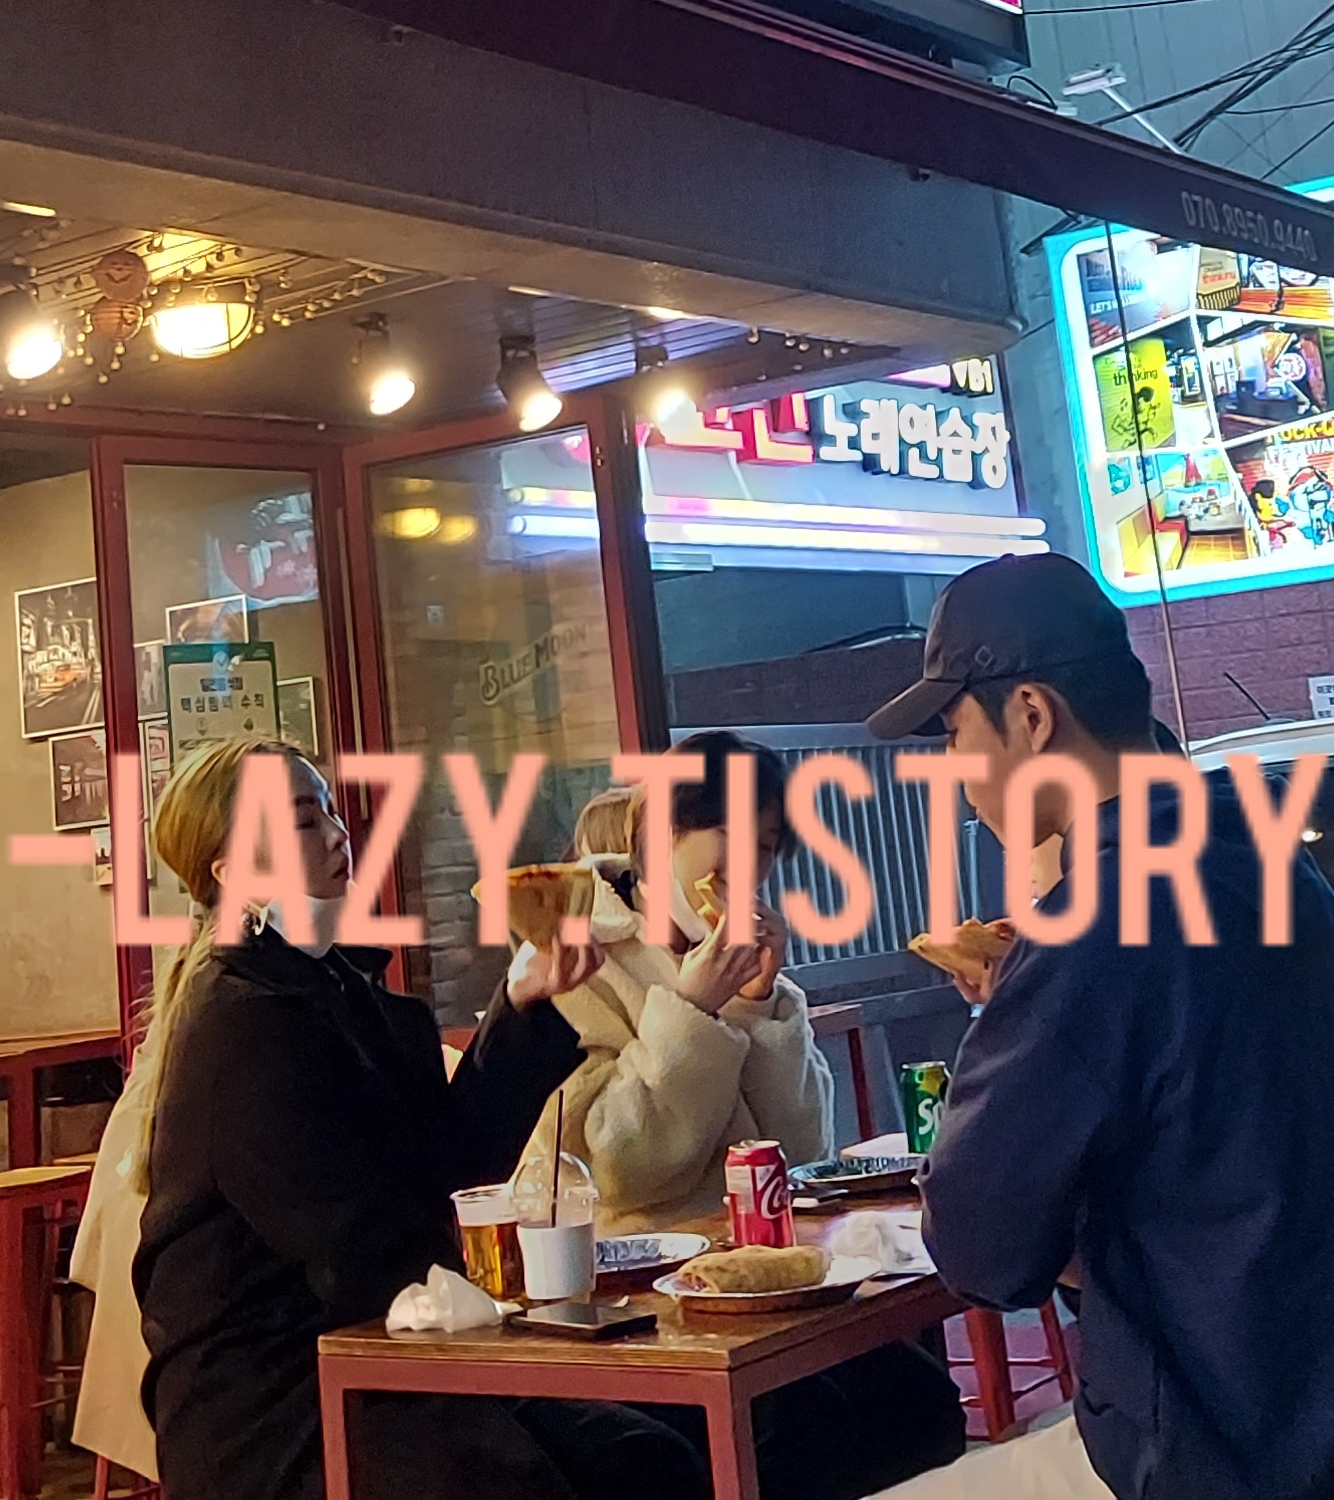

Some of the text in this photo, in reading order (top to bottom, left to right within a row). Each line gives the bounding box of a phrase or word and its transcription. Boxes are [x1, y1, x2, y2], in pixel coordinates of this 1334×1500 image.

[1113, 367, 1158, 387] thnking
[818, 393, 1012, 490] 노래연습장
[481, 650, 532, 702] BLUE
